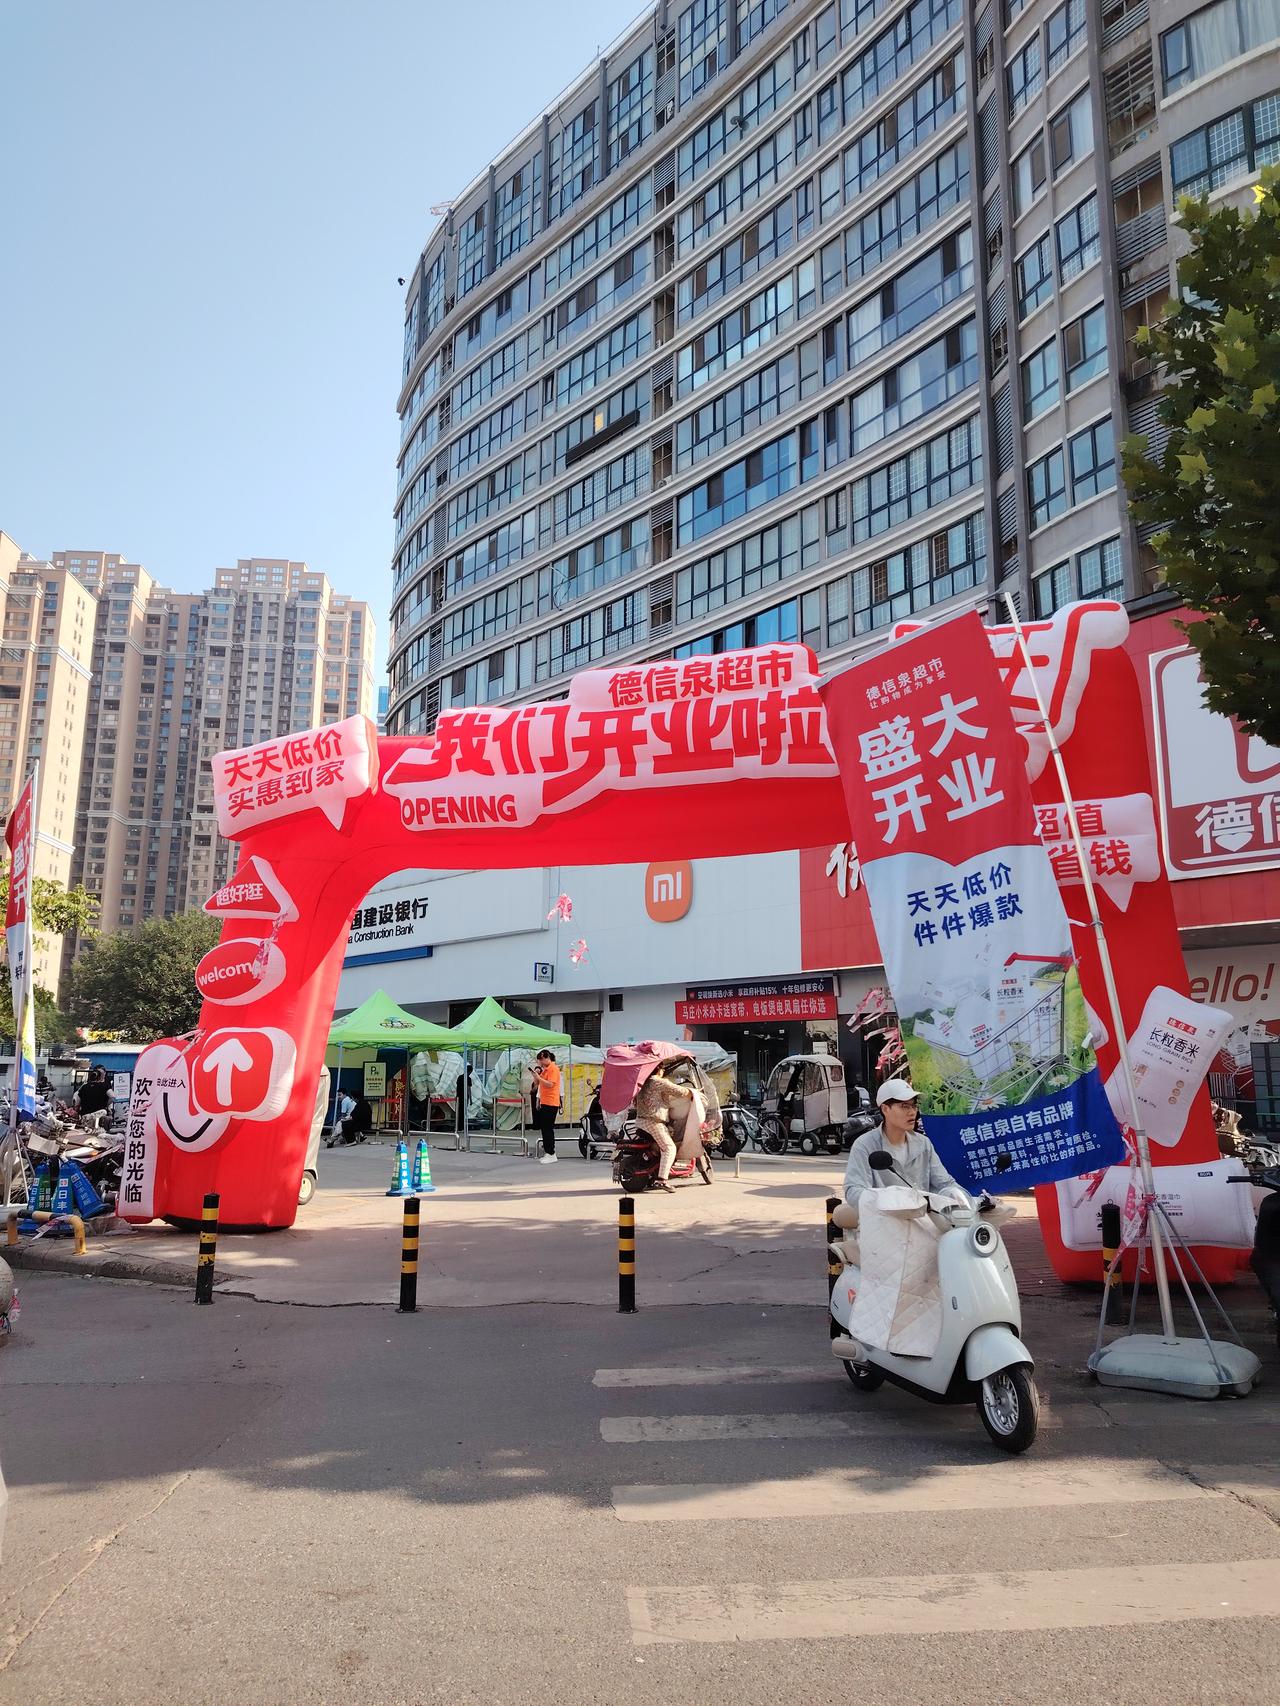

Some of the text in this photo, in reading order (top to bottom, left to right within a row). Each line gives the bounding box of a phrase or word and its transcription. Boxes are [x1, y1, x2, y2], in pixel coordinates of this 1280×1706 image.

[607, 651, 795, 708] 德信泉超市
[866, 657, 943, 701] 德信泉超市
[224, 728, 343, 787] 天天低价
[387, 686, 836, 807] 我们开业啦
[228, 760, 345, 818] 实惠到家
[402, 793, 517, 826] OPENING
[1047, 839, 1133, 880] 省钱
[215, 882, 264, 907] 超好逛
[906, 861, 1013, 917] 天天低价
[354, 927, 395, 944] Construction
[395, 922, 414, 937] Bank
[913, 891, 1024, 948] 件件爆款
[198, 959, 258, 987] welcom
[1149, 1027, 1200, 1059] 长粒香米
[959, 1101, 1074, 1146] 德信泉自有品牌
